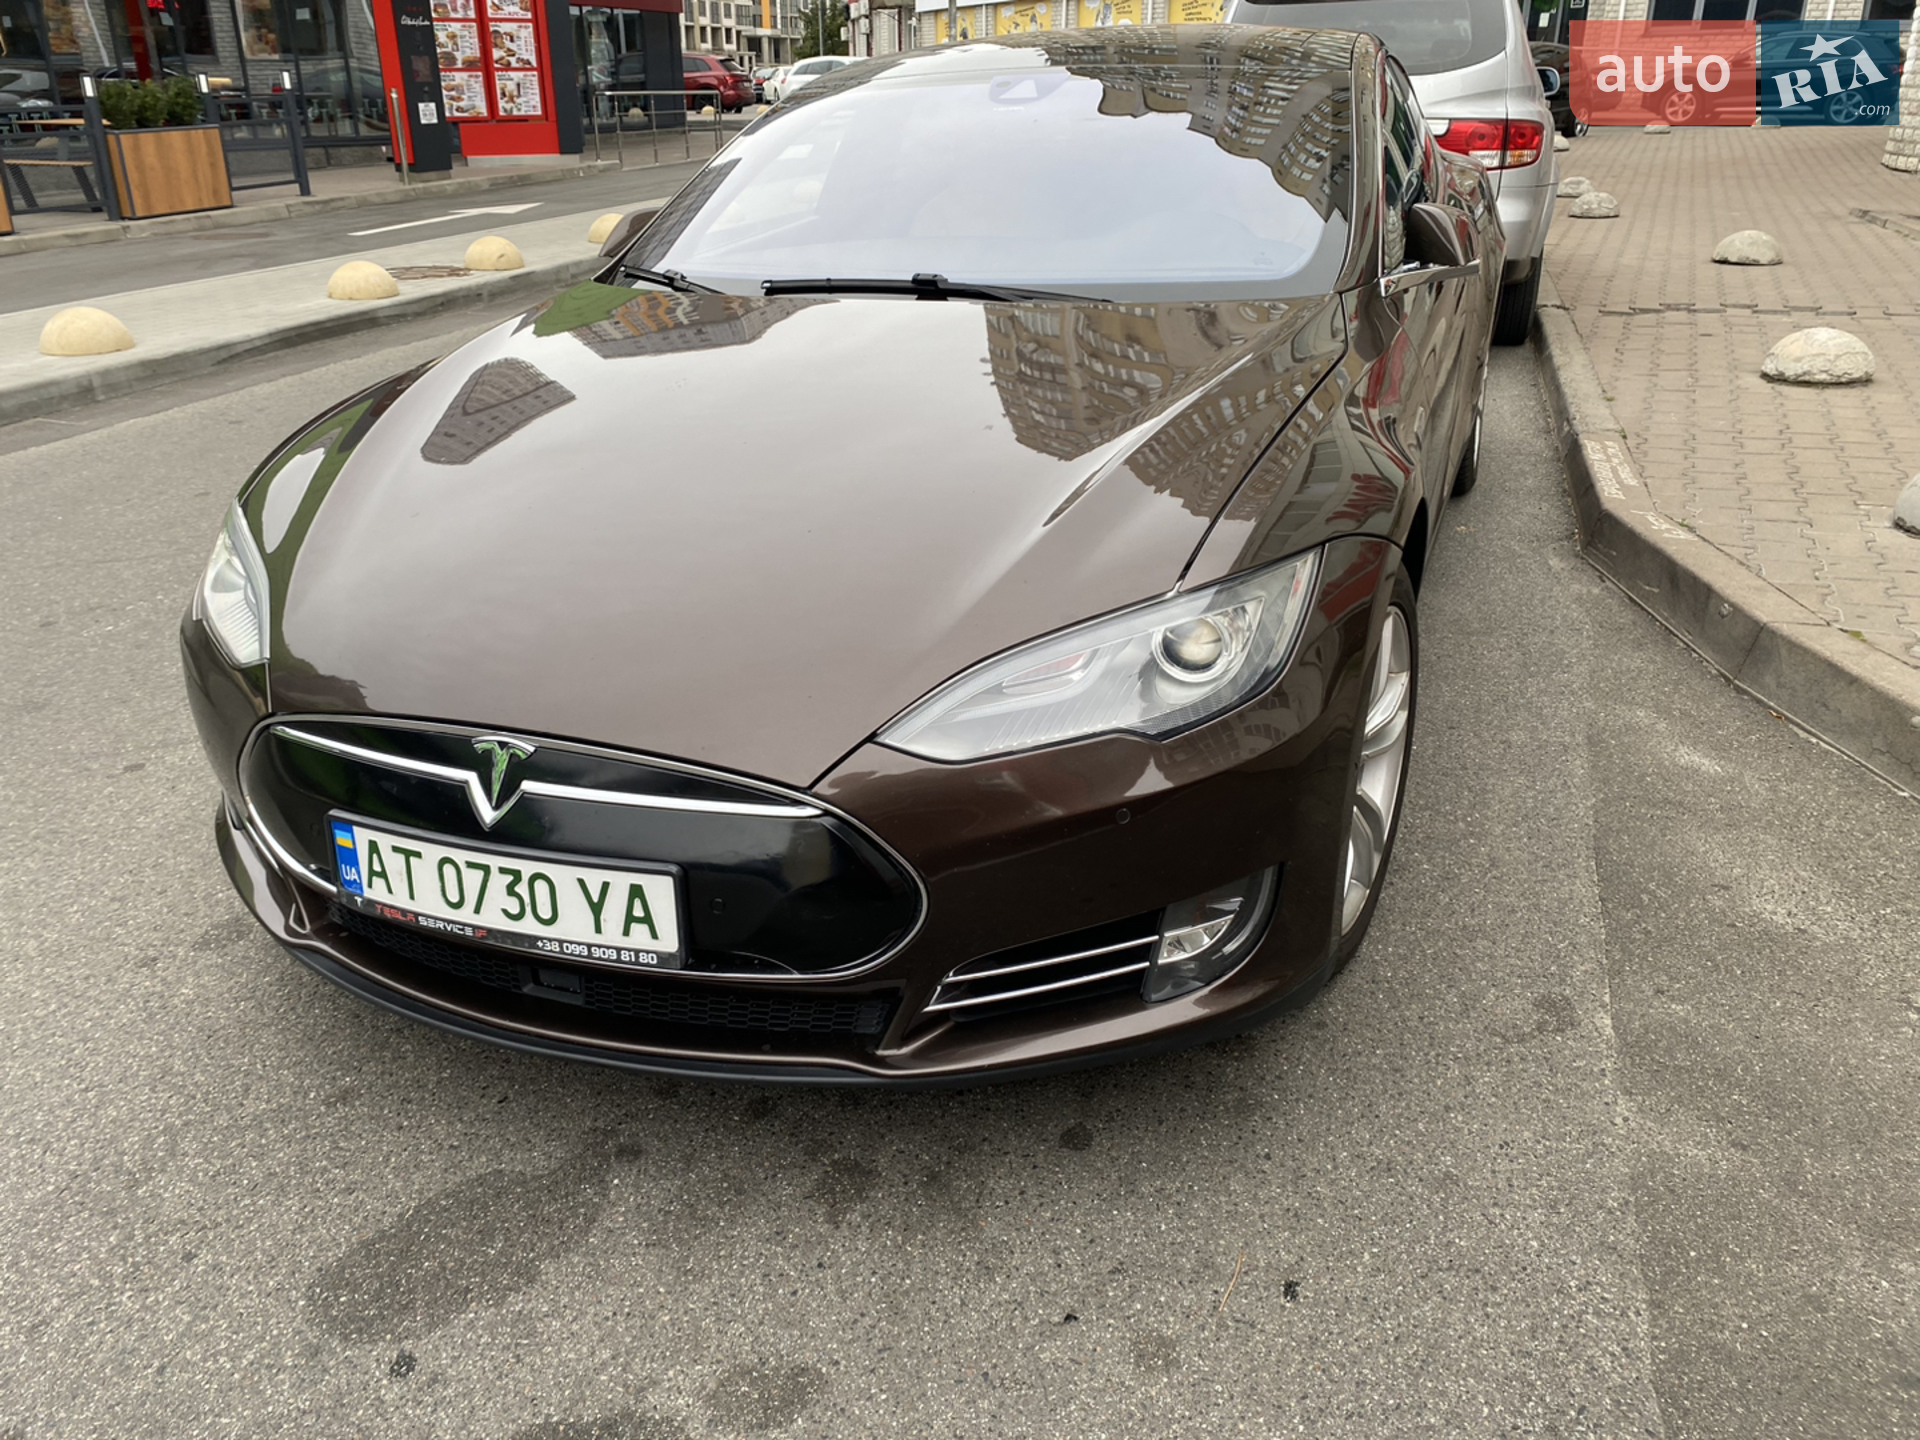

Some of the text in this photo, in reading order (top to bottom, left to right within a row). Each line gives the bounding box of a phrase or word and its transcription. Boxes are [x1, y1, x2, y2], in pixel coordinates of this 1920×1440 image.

[342, 864, 360, 883] UA
[367, 839, 659, 940] AT 0730 YA
[375, 903, 416, 923] TESLA
[418, 916, 474, 936] SERVICE
[536, 939, 657, 965] +38 099 909 81 80
